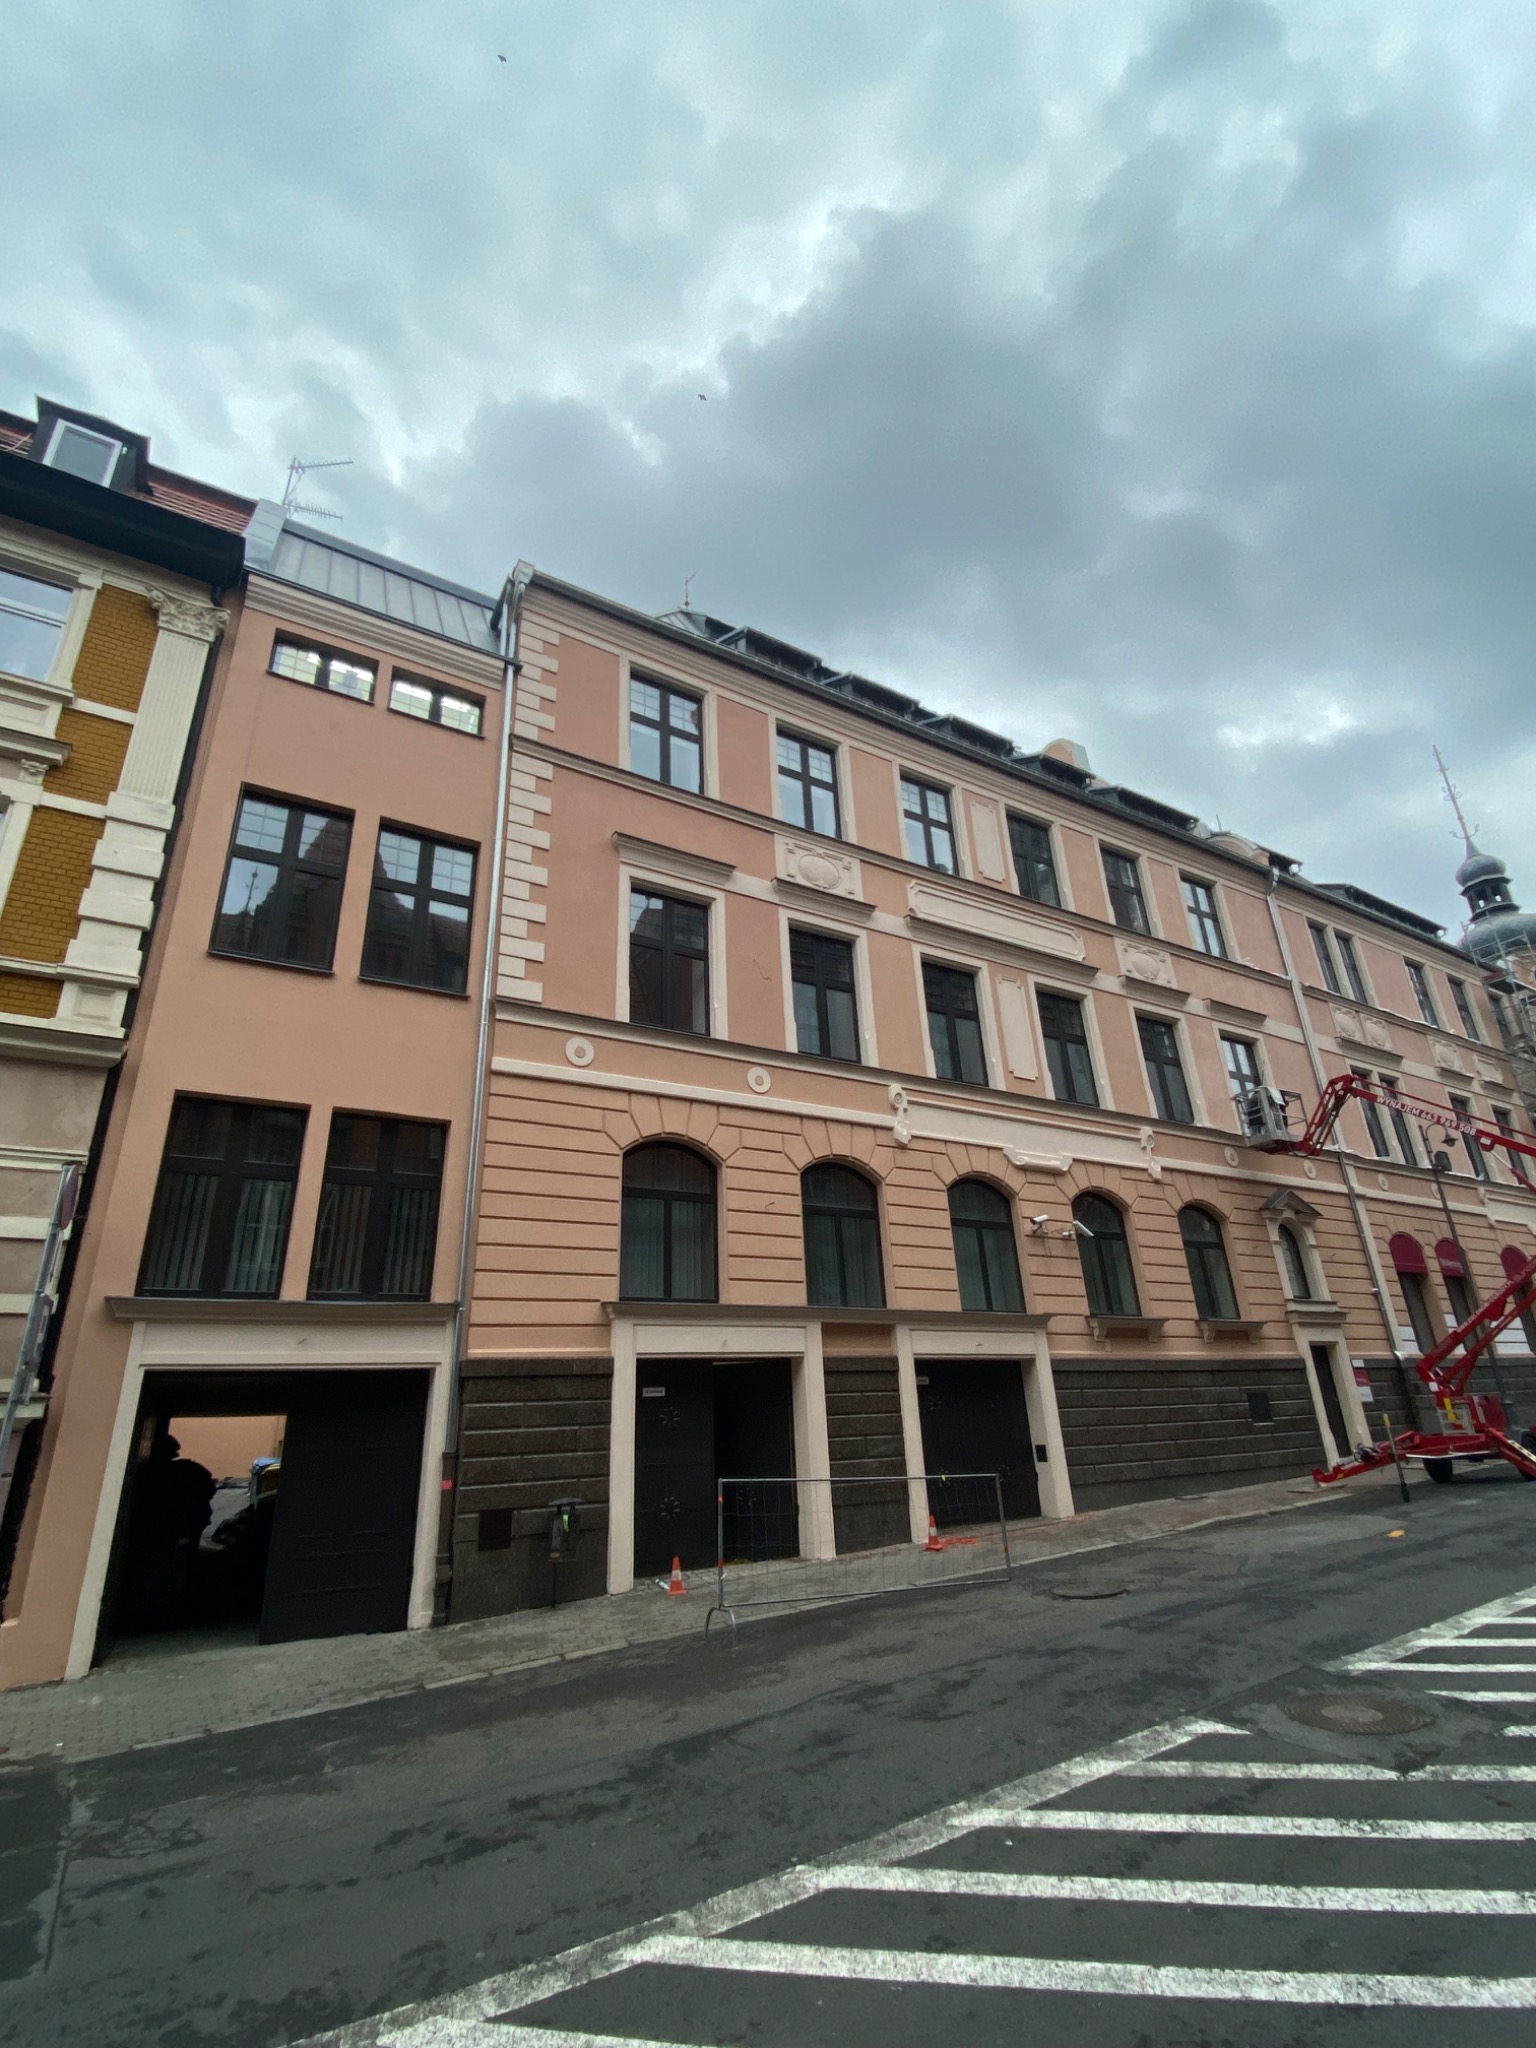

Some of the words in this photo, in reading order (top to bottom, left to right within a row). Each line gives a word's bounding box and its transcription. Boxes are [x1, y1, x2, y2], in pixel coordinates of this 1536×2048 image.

[1377, 1095, 1420, 1116] WYNAJEM
[1420, 1111, 1438, 1122] 663
[1440, 1116, 1458, 1128] 969
[1459, 1123, 1477, 1136] 508
